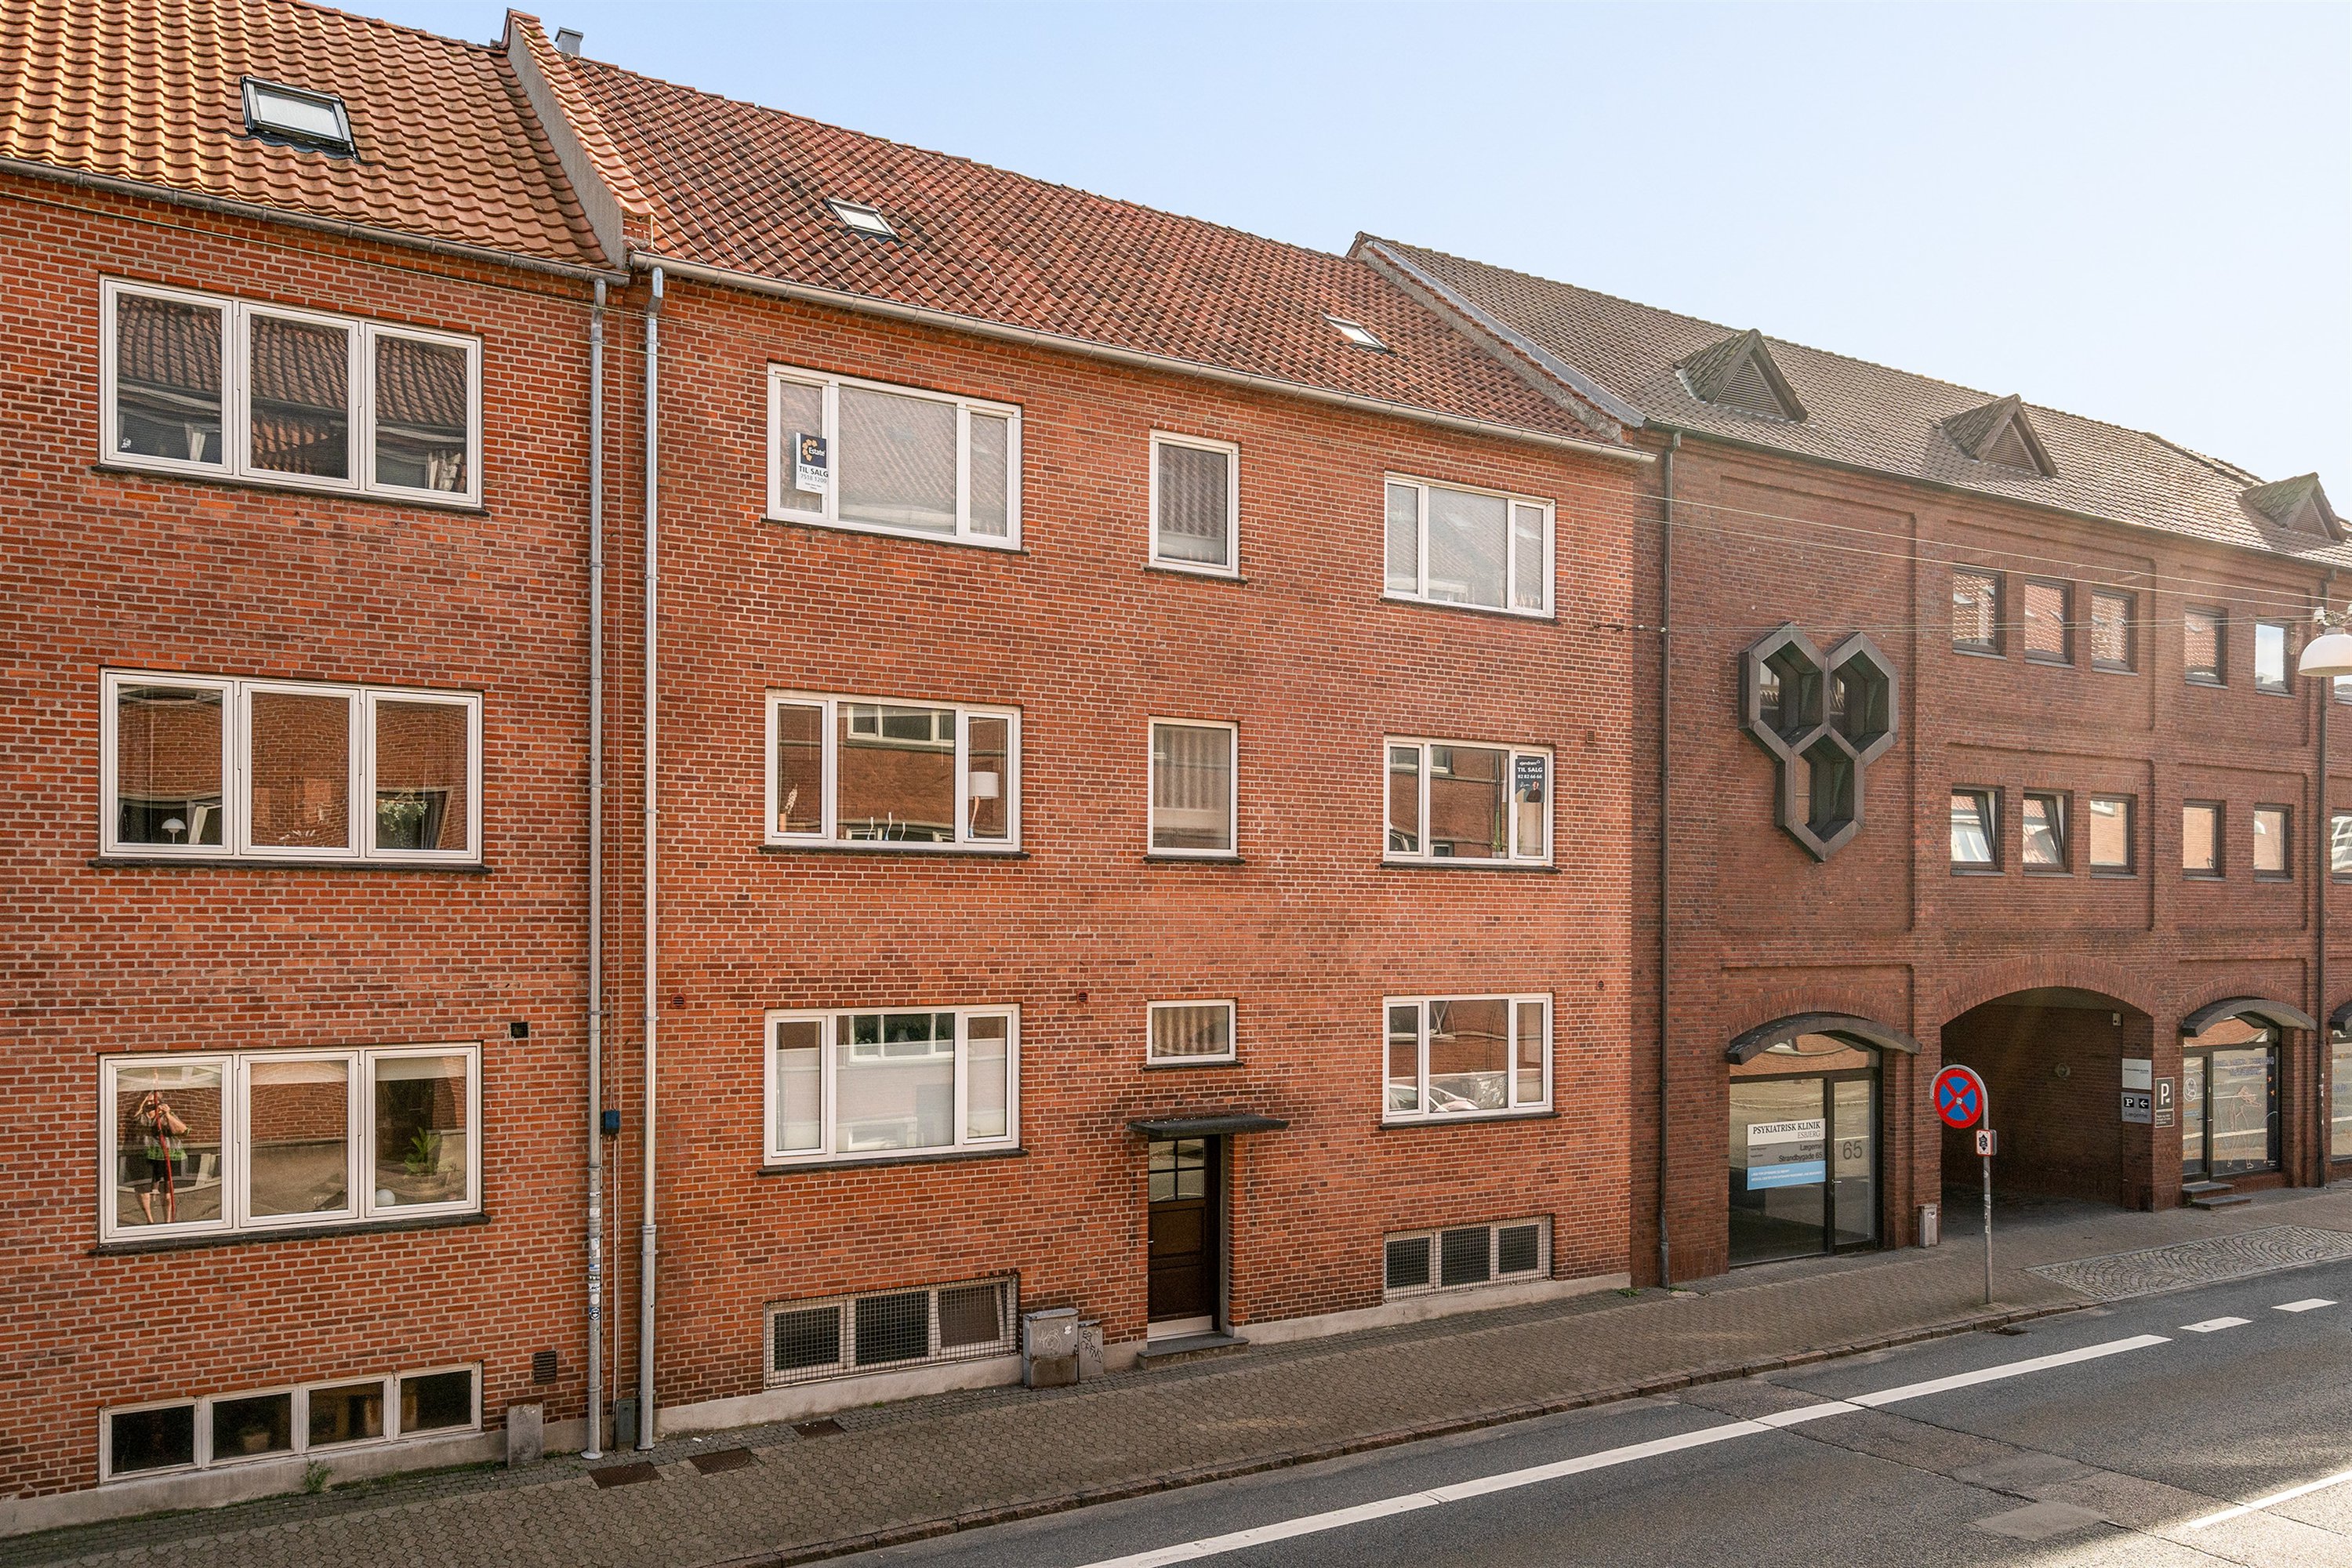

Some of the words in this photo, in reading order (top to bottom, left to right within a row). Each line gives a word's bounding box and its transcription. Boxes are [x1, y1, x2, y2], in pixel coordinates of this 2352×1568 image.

[808, 447, 826, 456] Estate
[811, 468, 829, 477] SALG
[1753, 1123, 1796, 1134] PSYKIATRISK
[1798, 1121, 1820, 1131] KLINIK
[1843, 1141, 1863, 1160] 65
[1778, 1152, 1815, 1162] Strandbygade
